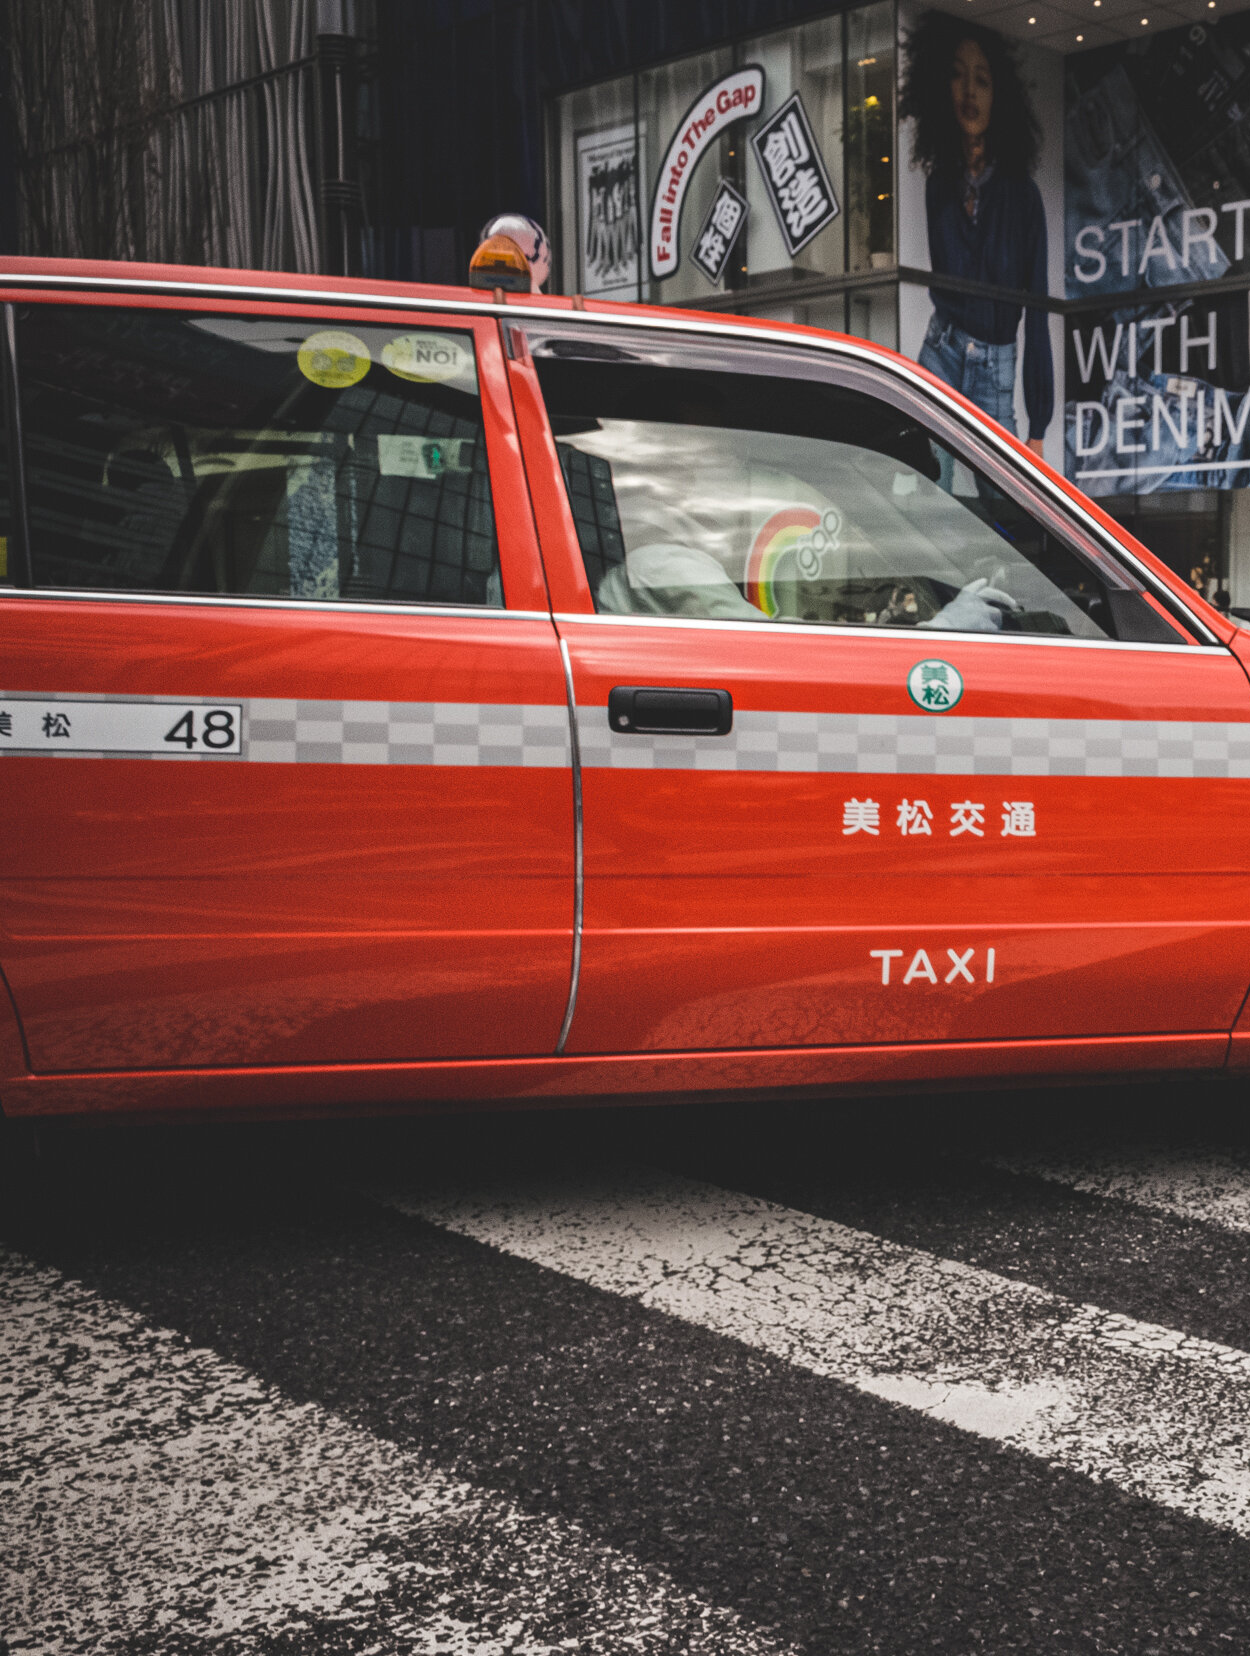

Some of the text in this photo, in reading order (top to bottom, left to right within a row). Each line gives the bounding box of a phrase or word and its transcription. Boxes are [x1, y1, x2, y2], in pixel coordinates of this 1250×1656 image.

[656, 83, 757, 263] Fall into The Gap
[416, 349, 457, 365] NO!
[1072, 310, 1217, 384] WITH
[921, 664, 950, 705] 美松
[163, 709, 235, 750] 48
[842, 797, 1037, 837] 美松交通
[869, 947, 996, 986] TAXI
